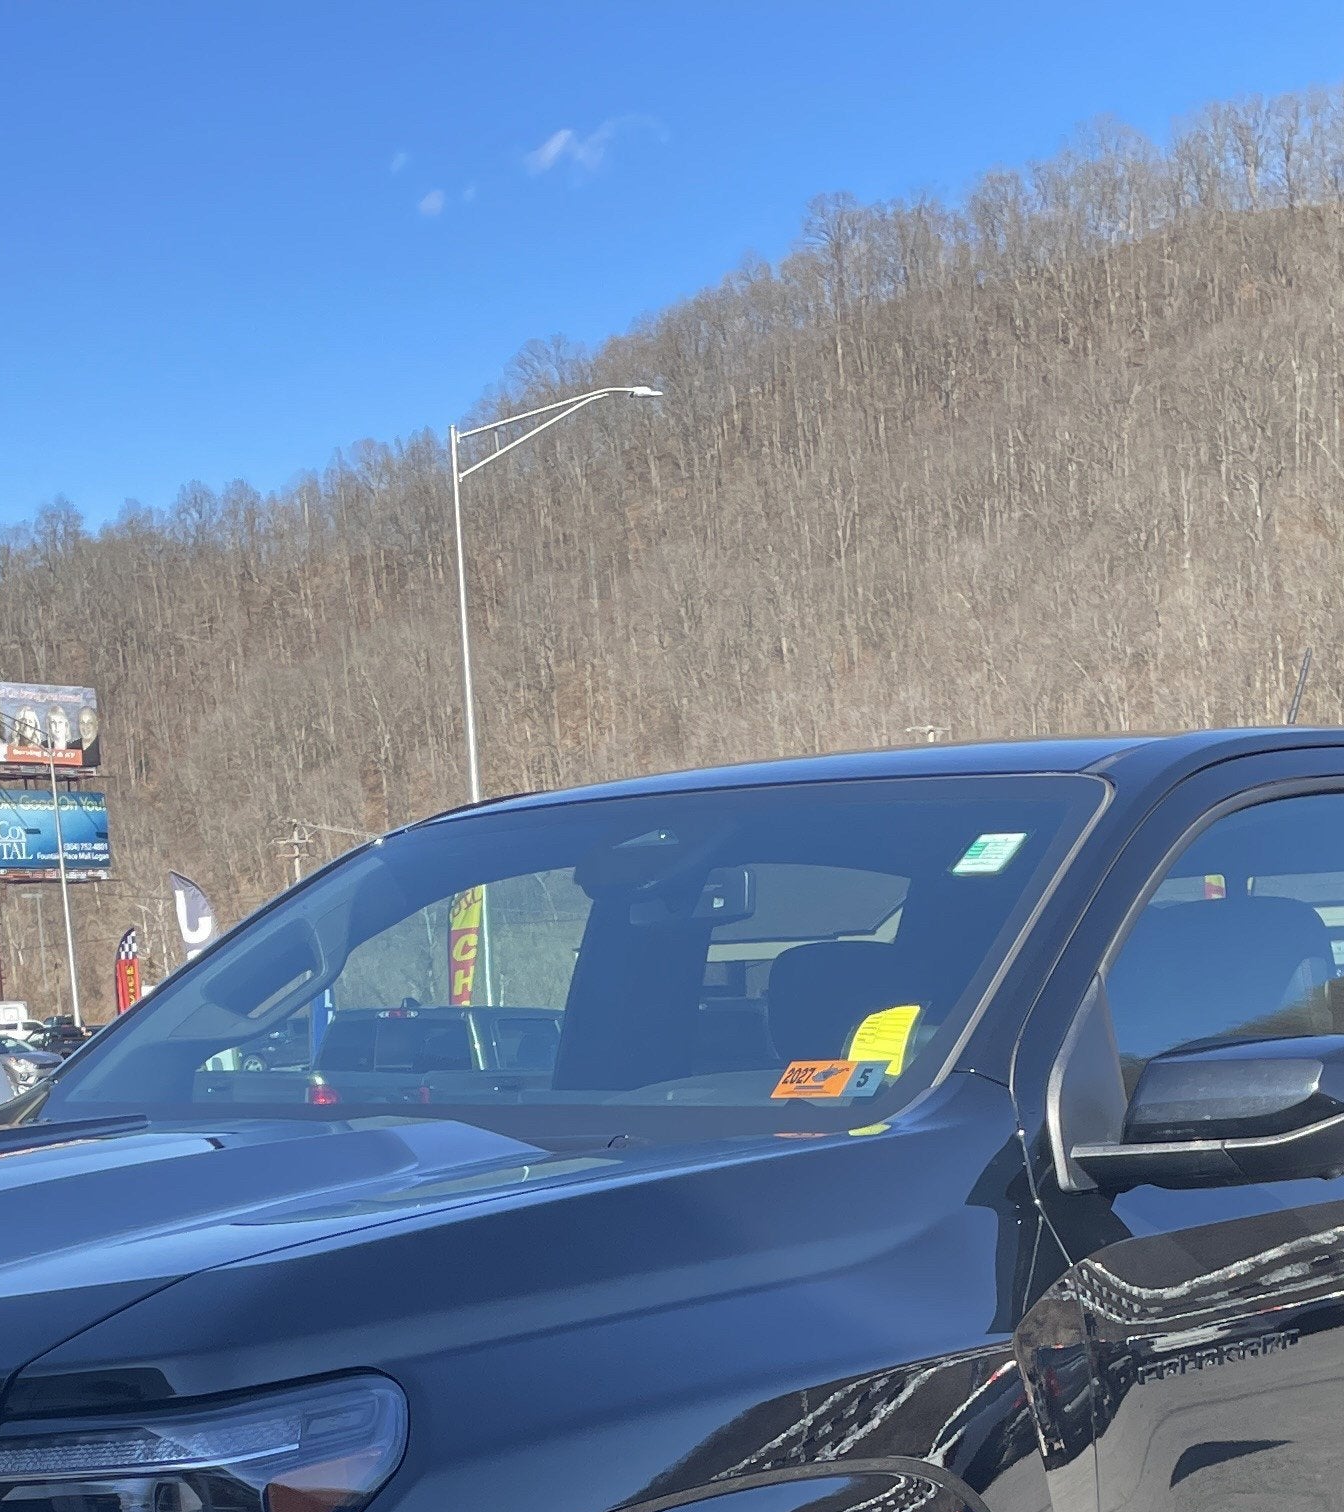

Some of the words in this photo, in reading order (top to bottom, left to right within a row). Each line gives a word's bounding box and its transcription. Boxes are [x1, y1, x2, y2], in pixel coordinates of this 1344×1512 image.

[79, 796, 107, 812] You!
[92, 851, 110, 862] Logan
[782, 1067, 816, 1085] 2027
[856, 1068, 873, 1088] 5
